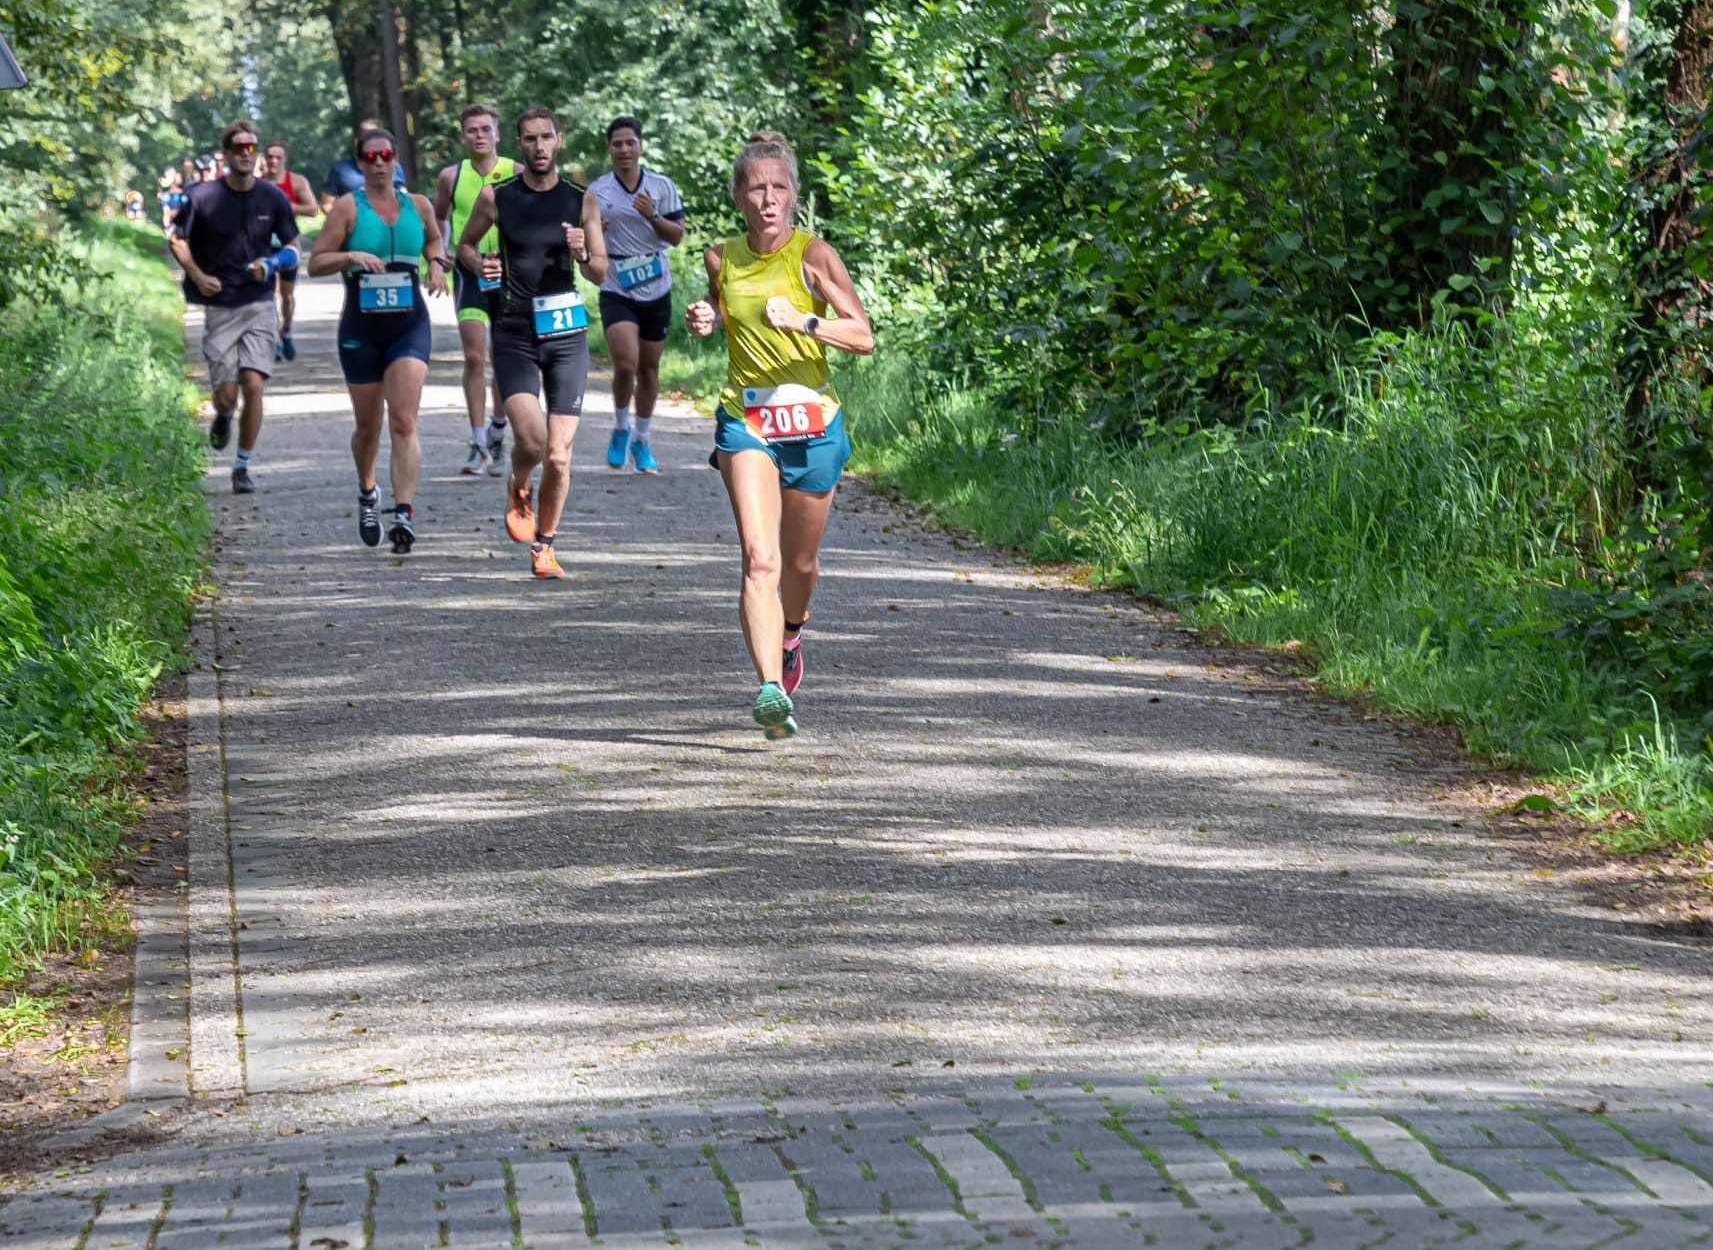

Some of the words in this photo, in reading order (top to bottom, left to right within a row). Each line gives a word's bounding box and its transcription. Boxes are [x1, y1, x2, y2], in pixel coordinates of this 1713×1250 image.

[627, 264, 656, 285] 102
[376, 288, 398, 307] 35
[552, 308, 573, 330] 21
[759, 405, 810, 435] 206
